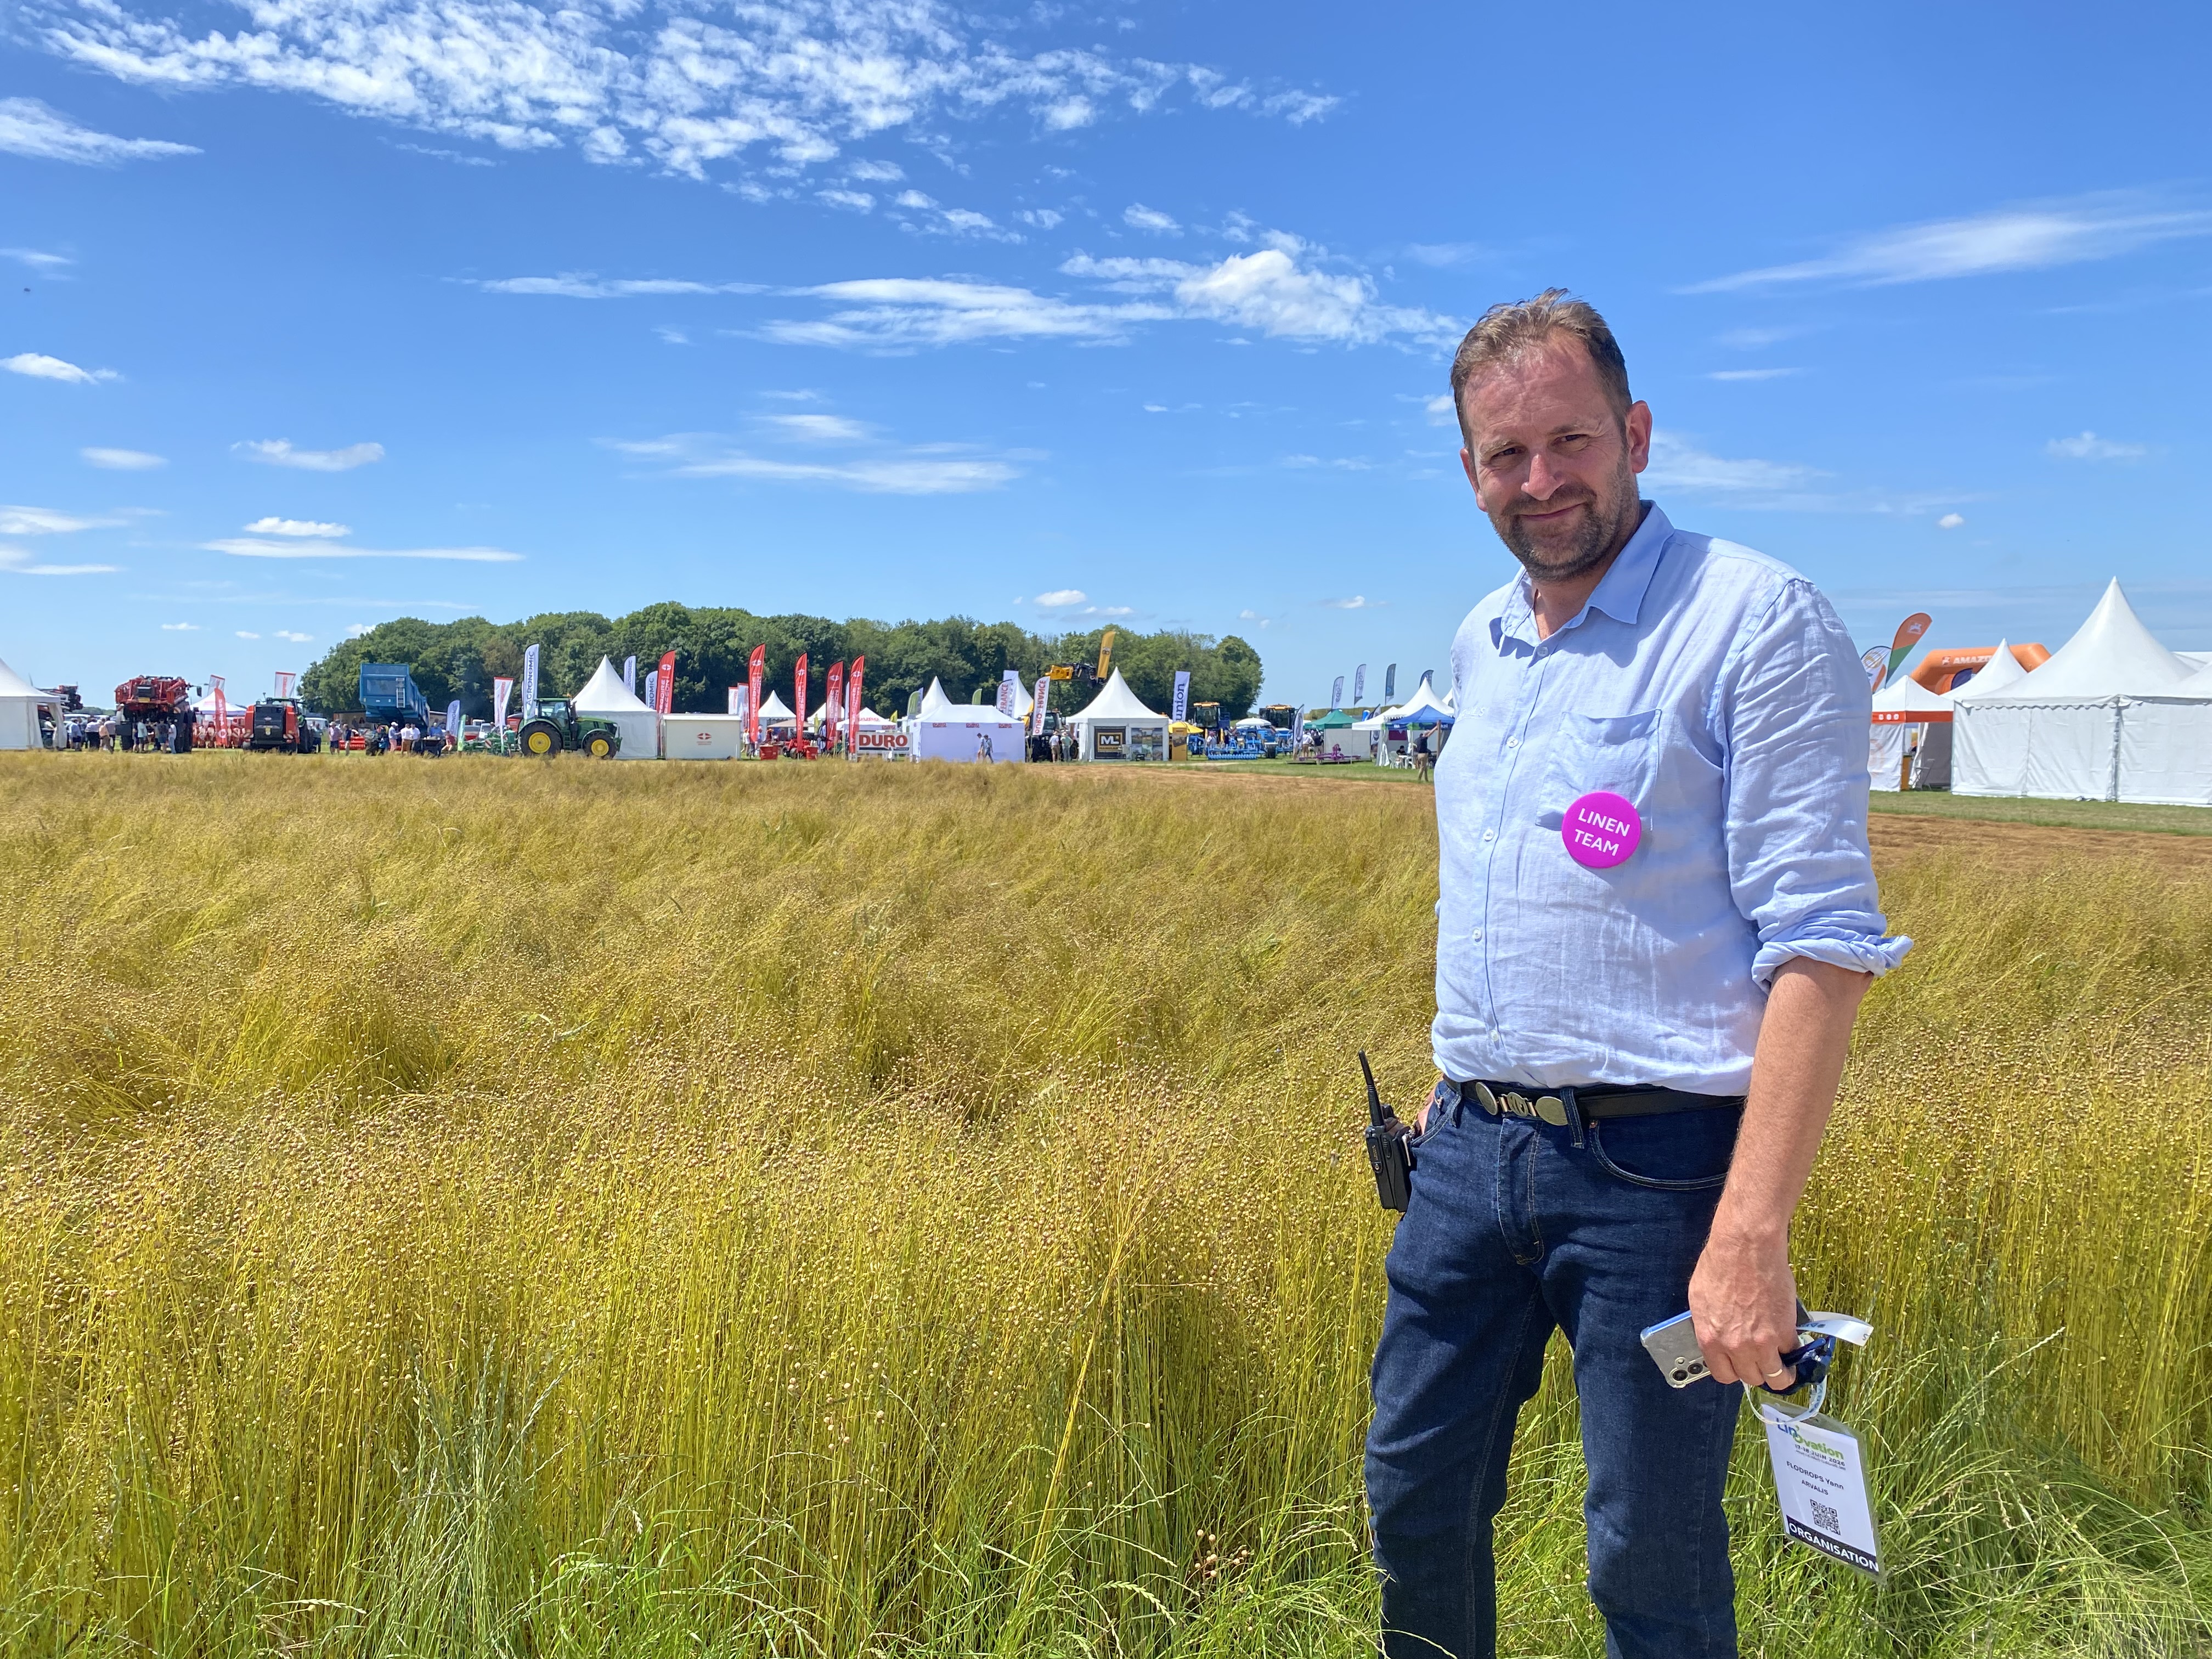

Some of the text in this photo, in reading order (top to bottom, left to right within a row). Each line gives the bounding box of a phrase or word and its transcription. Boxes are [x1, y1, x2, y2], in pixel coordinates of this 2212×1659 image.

[526, 651, 534, 706] AGRONOMIC
[1175, 683, 1185, 721] union
[859, 735, 908, 749] DURO
[1578, 808, 1630, 837] LINEN
[1575, 828, 1619, 856] TEAM
[1810, 1450, 1826, 1460] JUIN
[1786, 1460, 1844, 1490] FLODROPS Yann
[1801, 1480, 1829, 1496] ARVALIS
[1789, 1522, 1880, 1572] ORGANISATION
